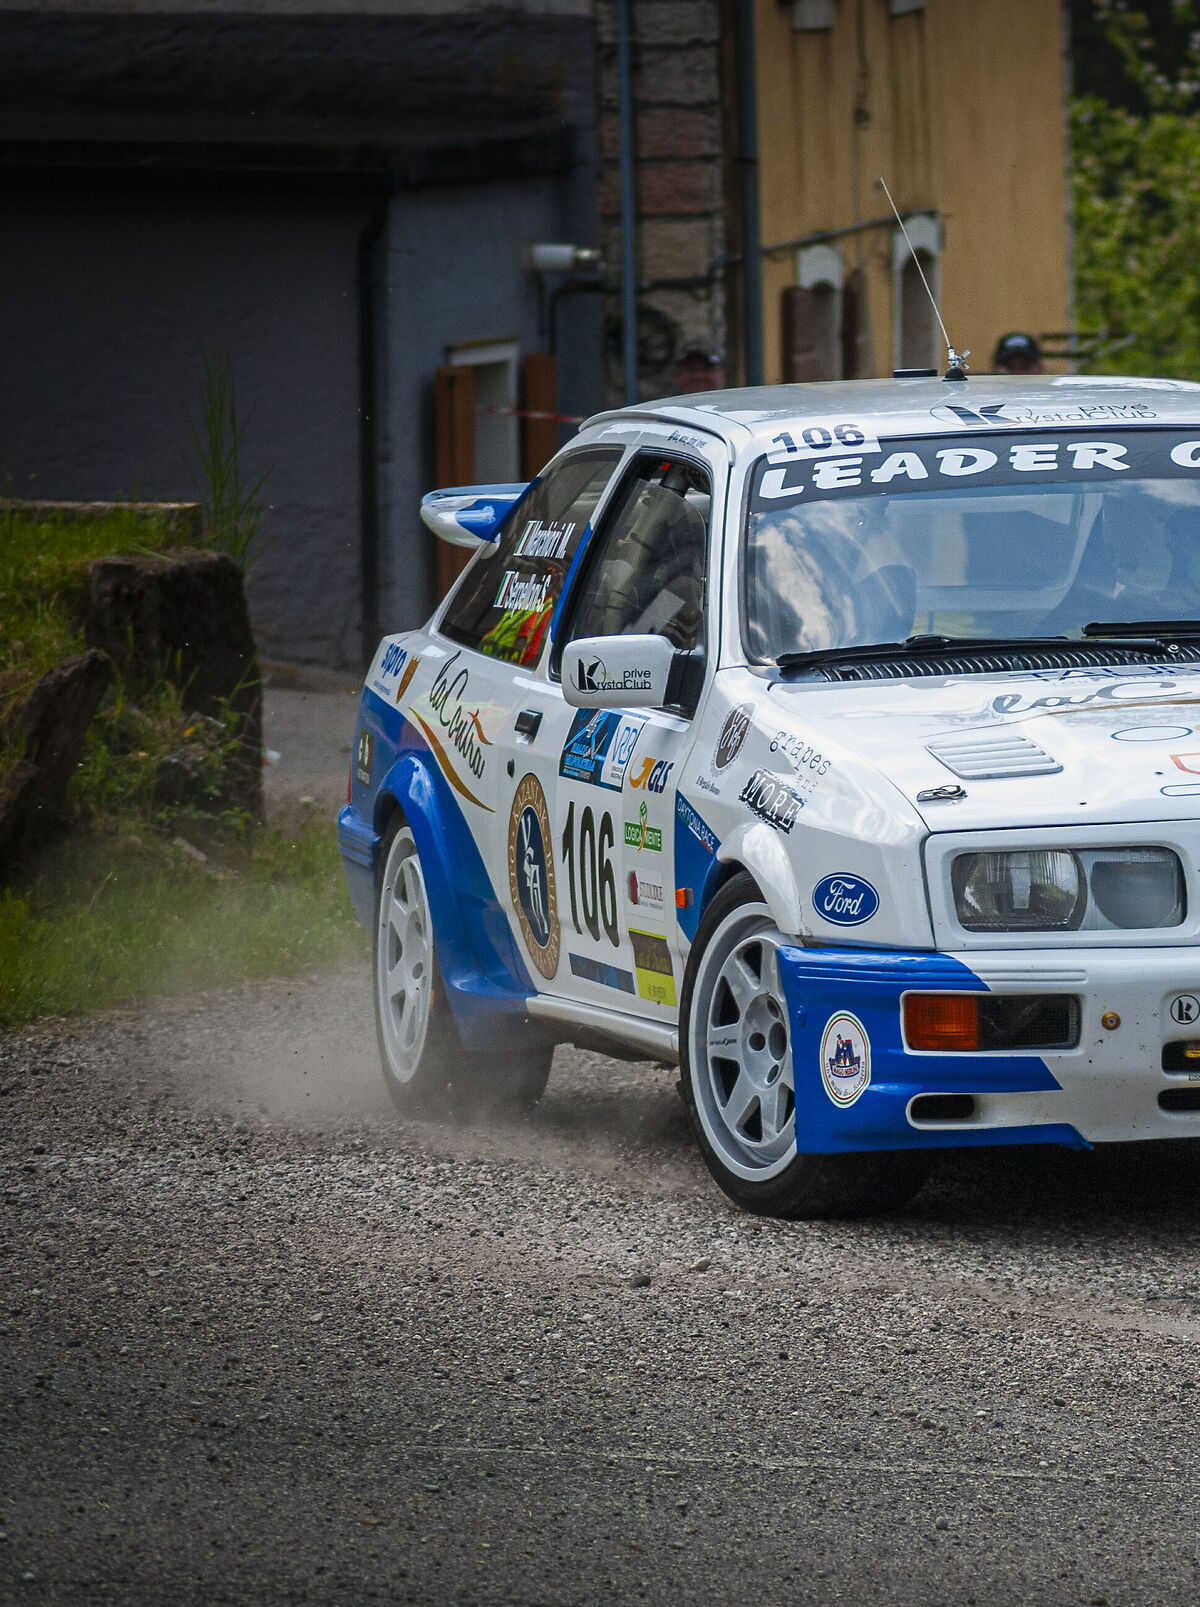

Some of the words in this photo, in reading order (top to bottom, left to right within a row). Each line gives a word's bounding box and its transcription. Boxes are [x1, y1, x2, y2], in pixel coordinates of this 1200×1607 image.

[771, 423, 865, 454] 106
[758, 441, 1132, 499] LEADER
[623, 669, 652, 683] prive
[647, 760, 675, 794] GLS
[769, 731, 832, 777] grapes
[743, 772, 802, 830] MORE
[677, 798, 701, 834] DAYTONA
[700, 825, 715, 851] RACE
[562, 801, 620, 948] 106
[824, 879, 864, 916] Ford
